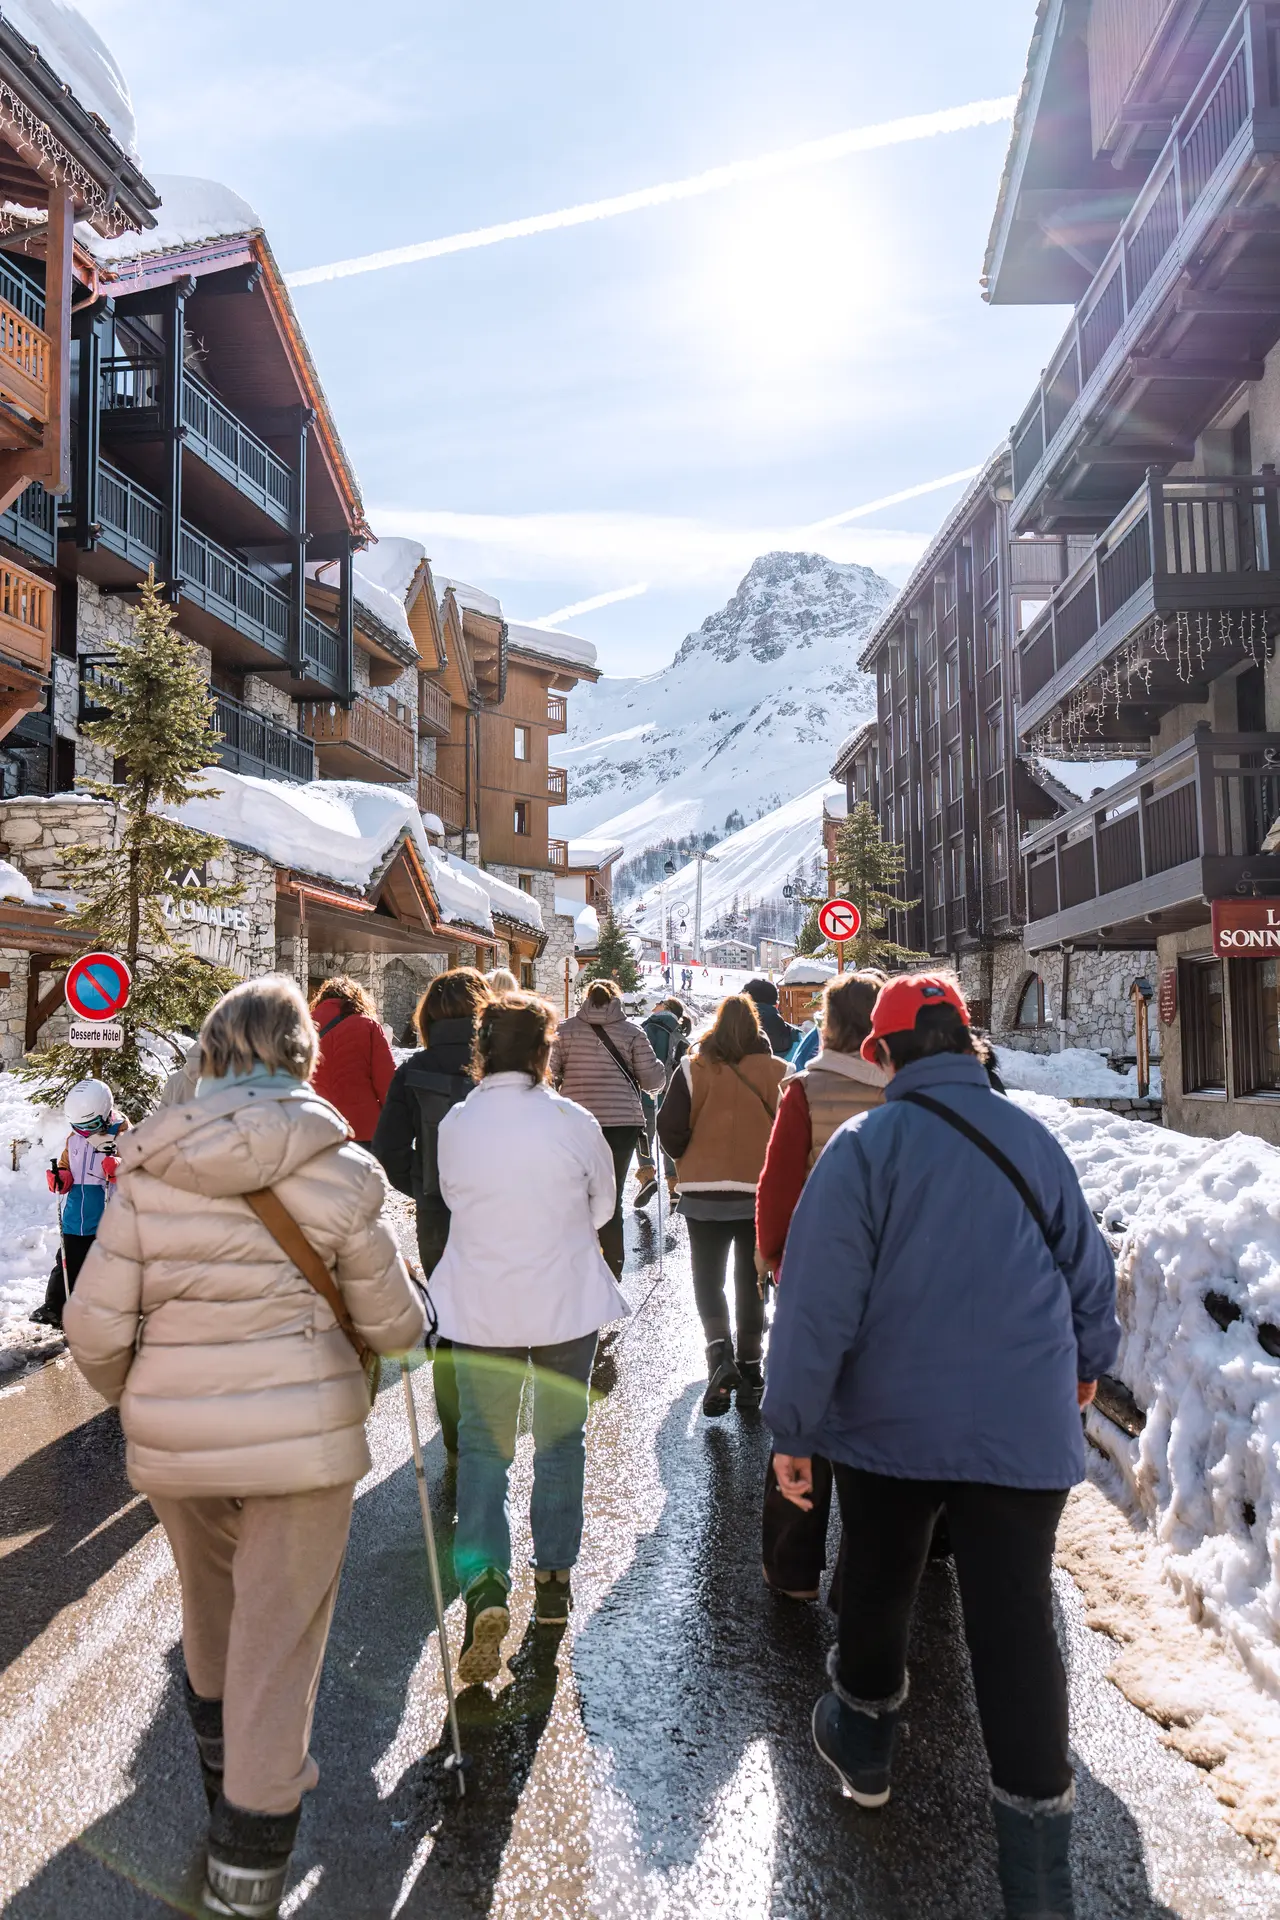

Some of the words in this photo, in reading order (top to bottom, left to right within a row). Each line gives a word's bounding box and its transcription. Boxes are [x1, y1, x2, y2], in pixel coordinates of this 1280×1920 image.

[180, 899, 250, 932] CIMALPES
[71, 1028, 101, 1041] Desserte
[102, 1029, 121, 1041] Hôtel
